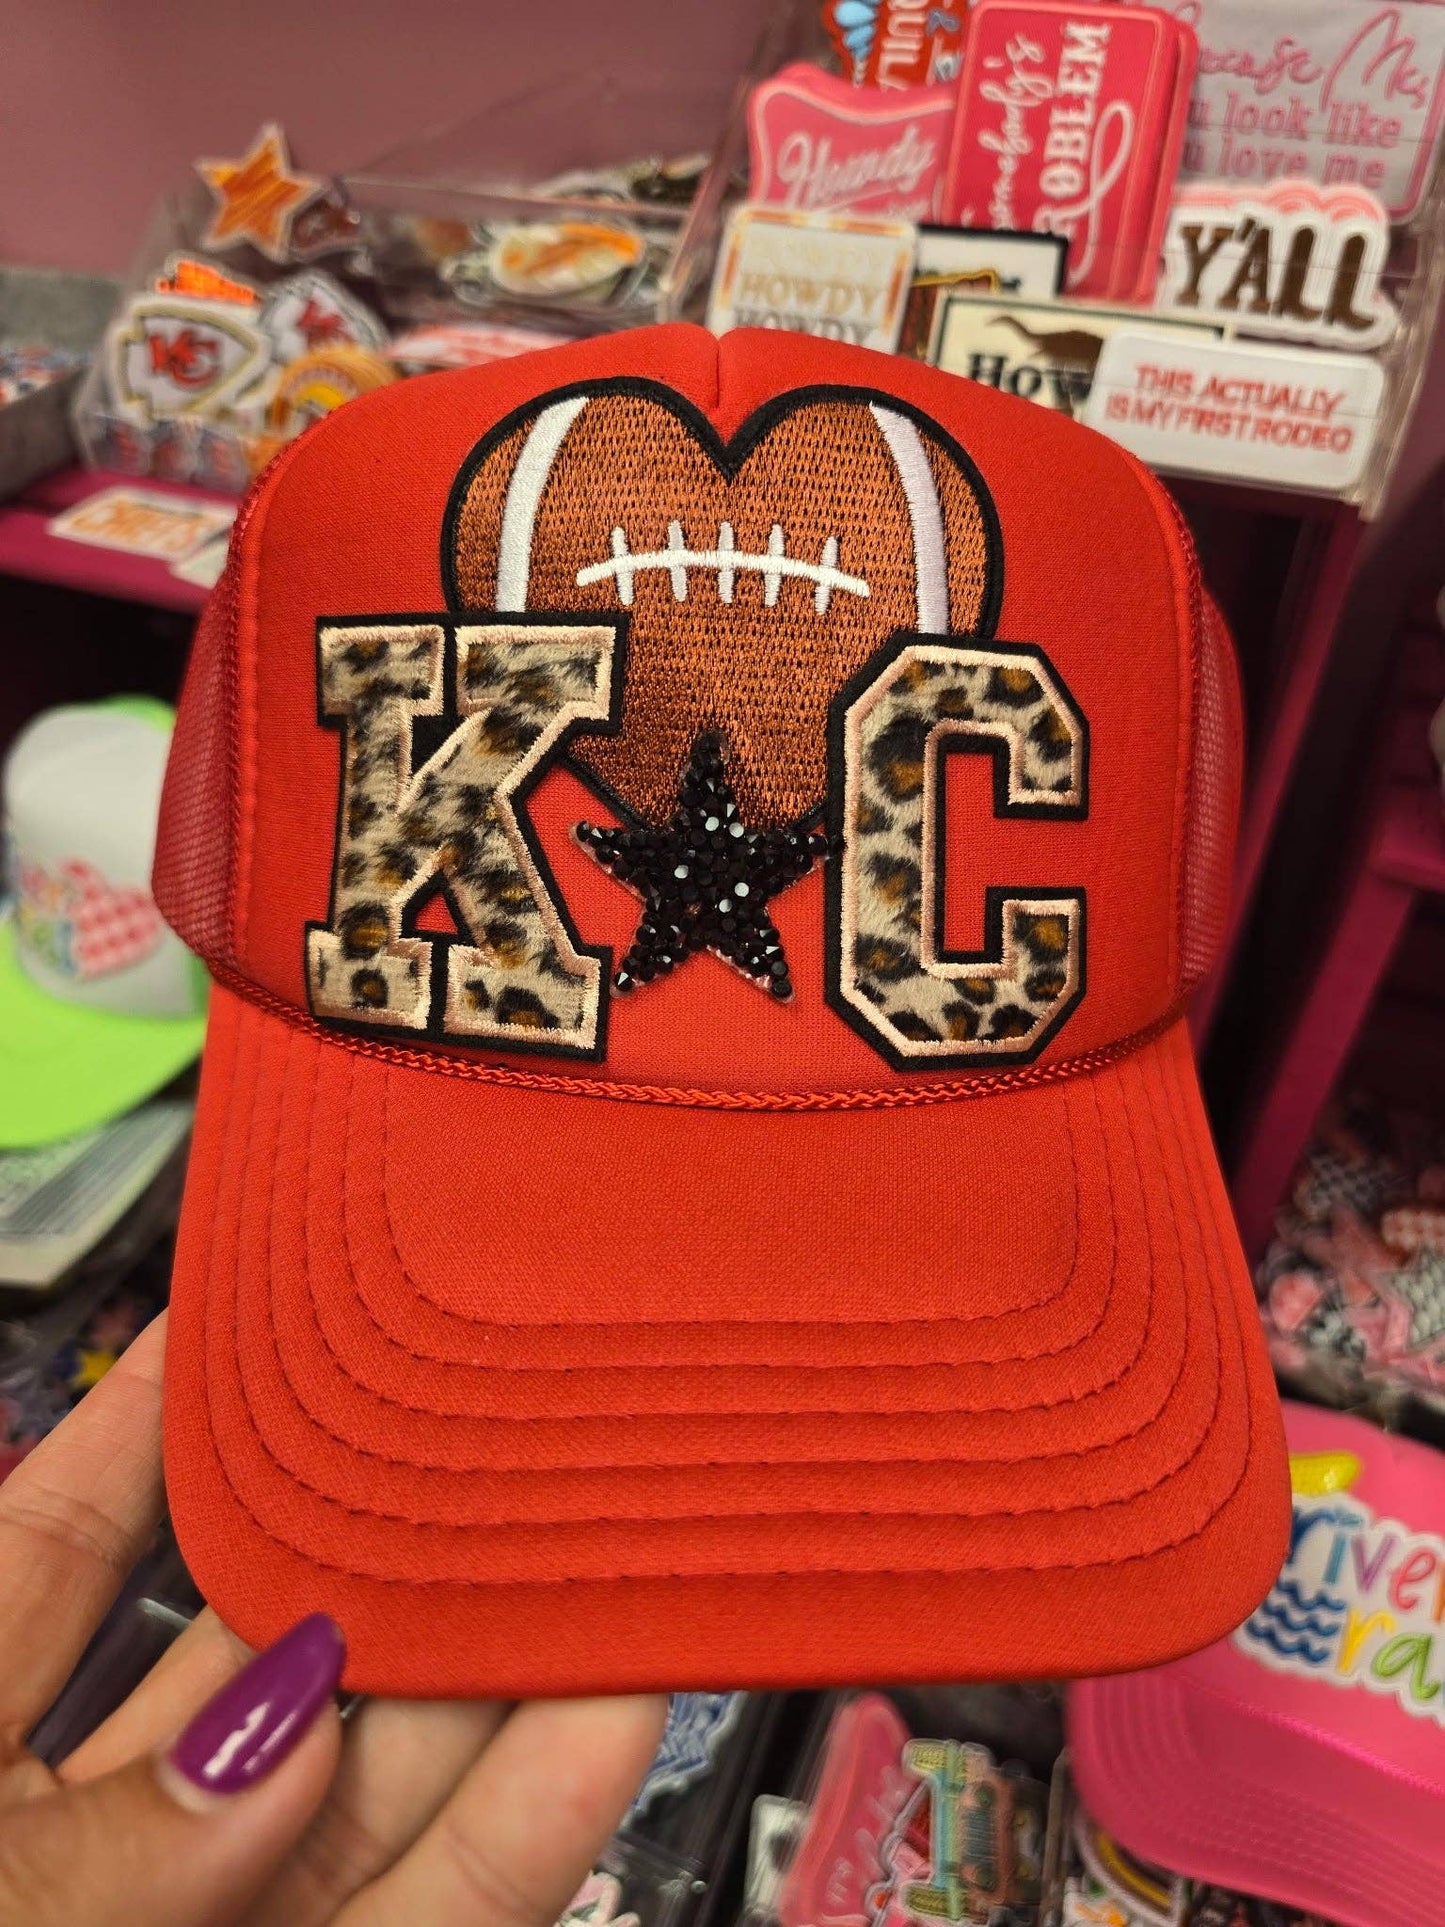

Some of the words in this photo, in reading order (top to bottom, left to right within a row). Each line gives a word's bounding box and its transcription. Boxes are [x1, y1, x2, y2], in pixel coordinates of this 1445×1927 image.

[960, 33, 1052, 229] omebody's
[1032, 21, 1118, 240] ROBLEM
[1224, 88, 1312, 141] look
[1322, 102, 1402, 148] like
[1218, 135, 1307, 178] love
[1321, 152, 1386, 189] me
[739, 273, 881, 315] HOWDY
[1135, 363, 1193, 394] THIS
[1201, 376, 1343, 418] ACTUALLY
[1105, 393, 1129, 422] IS
[1132, 400, 1172, 430] MY
[1175, 405, 1249, 441] FIRST
[1250, 415, 1354, 453] RODEO
[1336, 1610, 1445, 1699] ra
